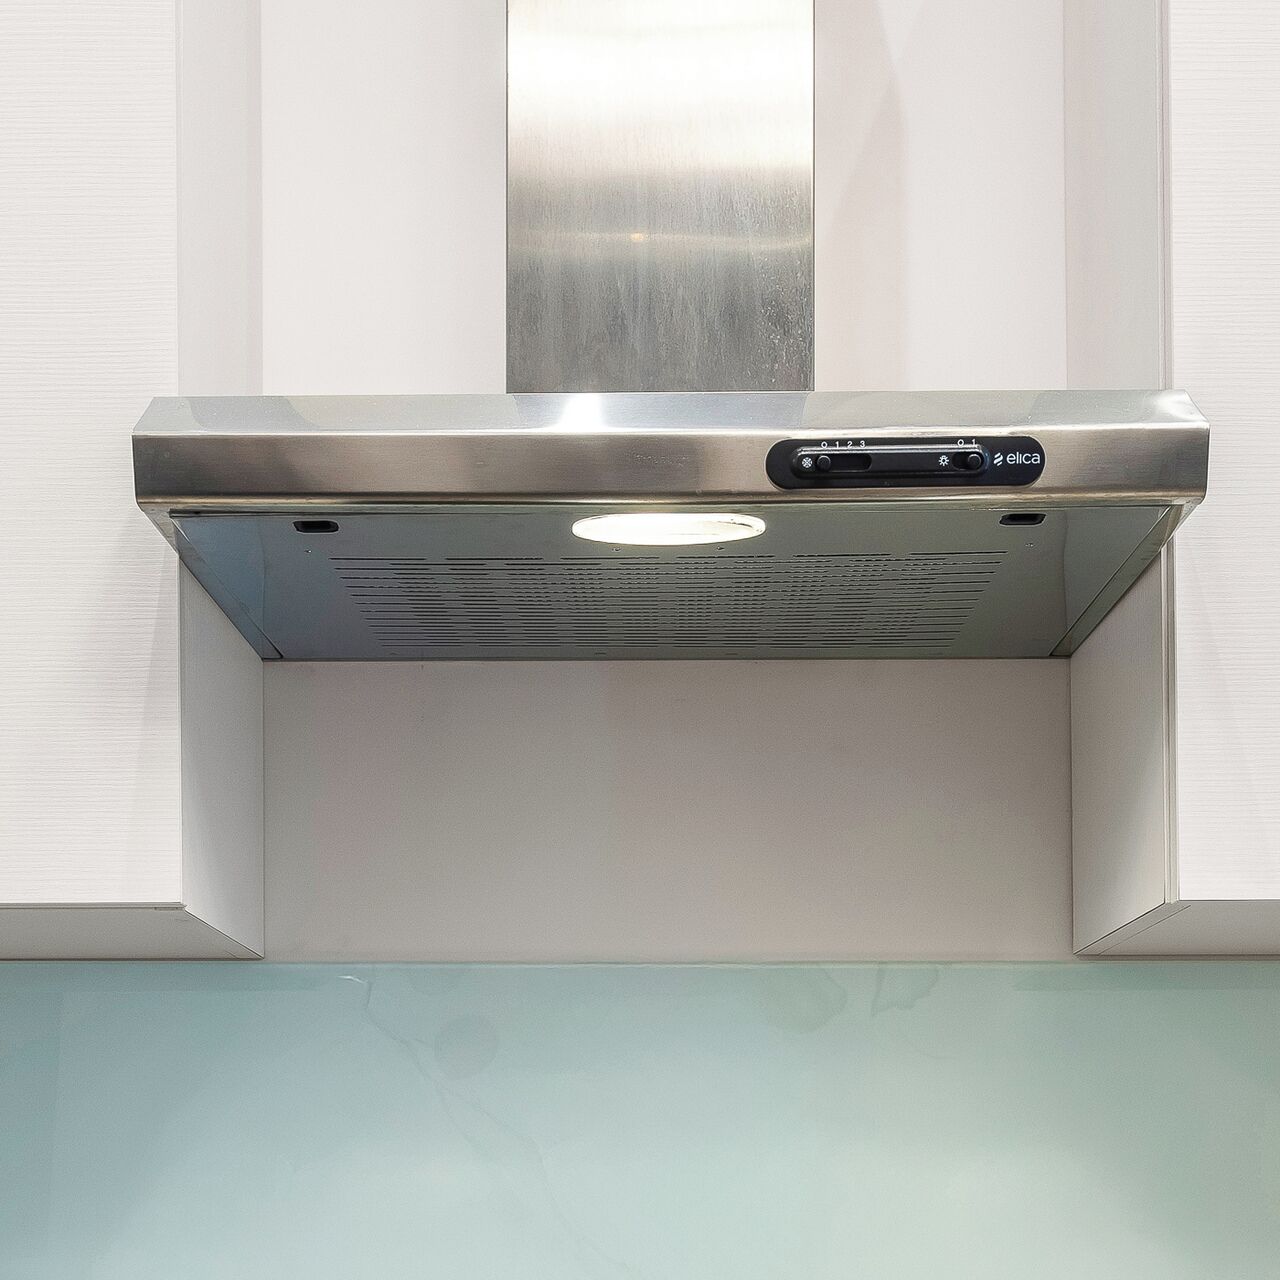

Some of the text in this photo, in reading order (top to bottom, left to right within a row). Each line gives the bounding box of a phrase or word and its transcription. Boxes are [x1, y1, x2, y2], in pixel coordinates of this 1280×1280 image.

[821, 441, 828, 449] 0
[847, 441, 853, 449] 2
[860, 440, 866, 448] 3
[1006, 451, 1041, 465] elica
